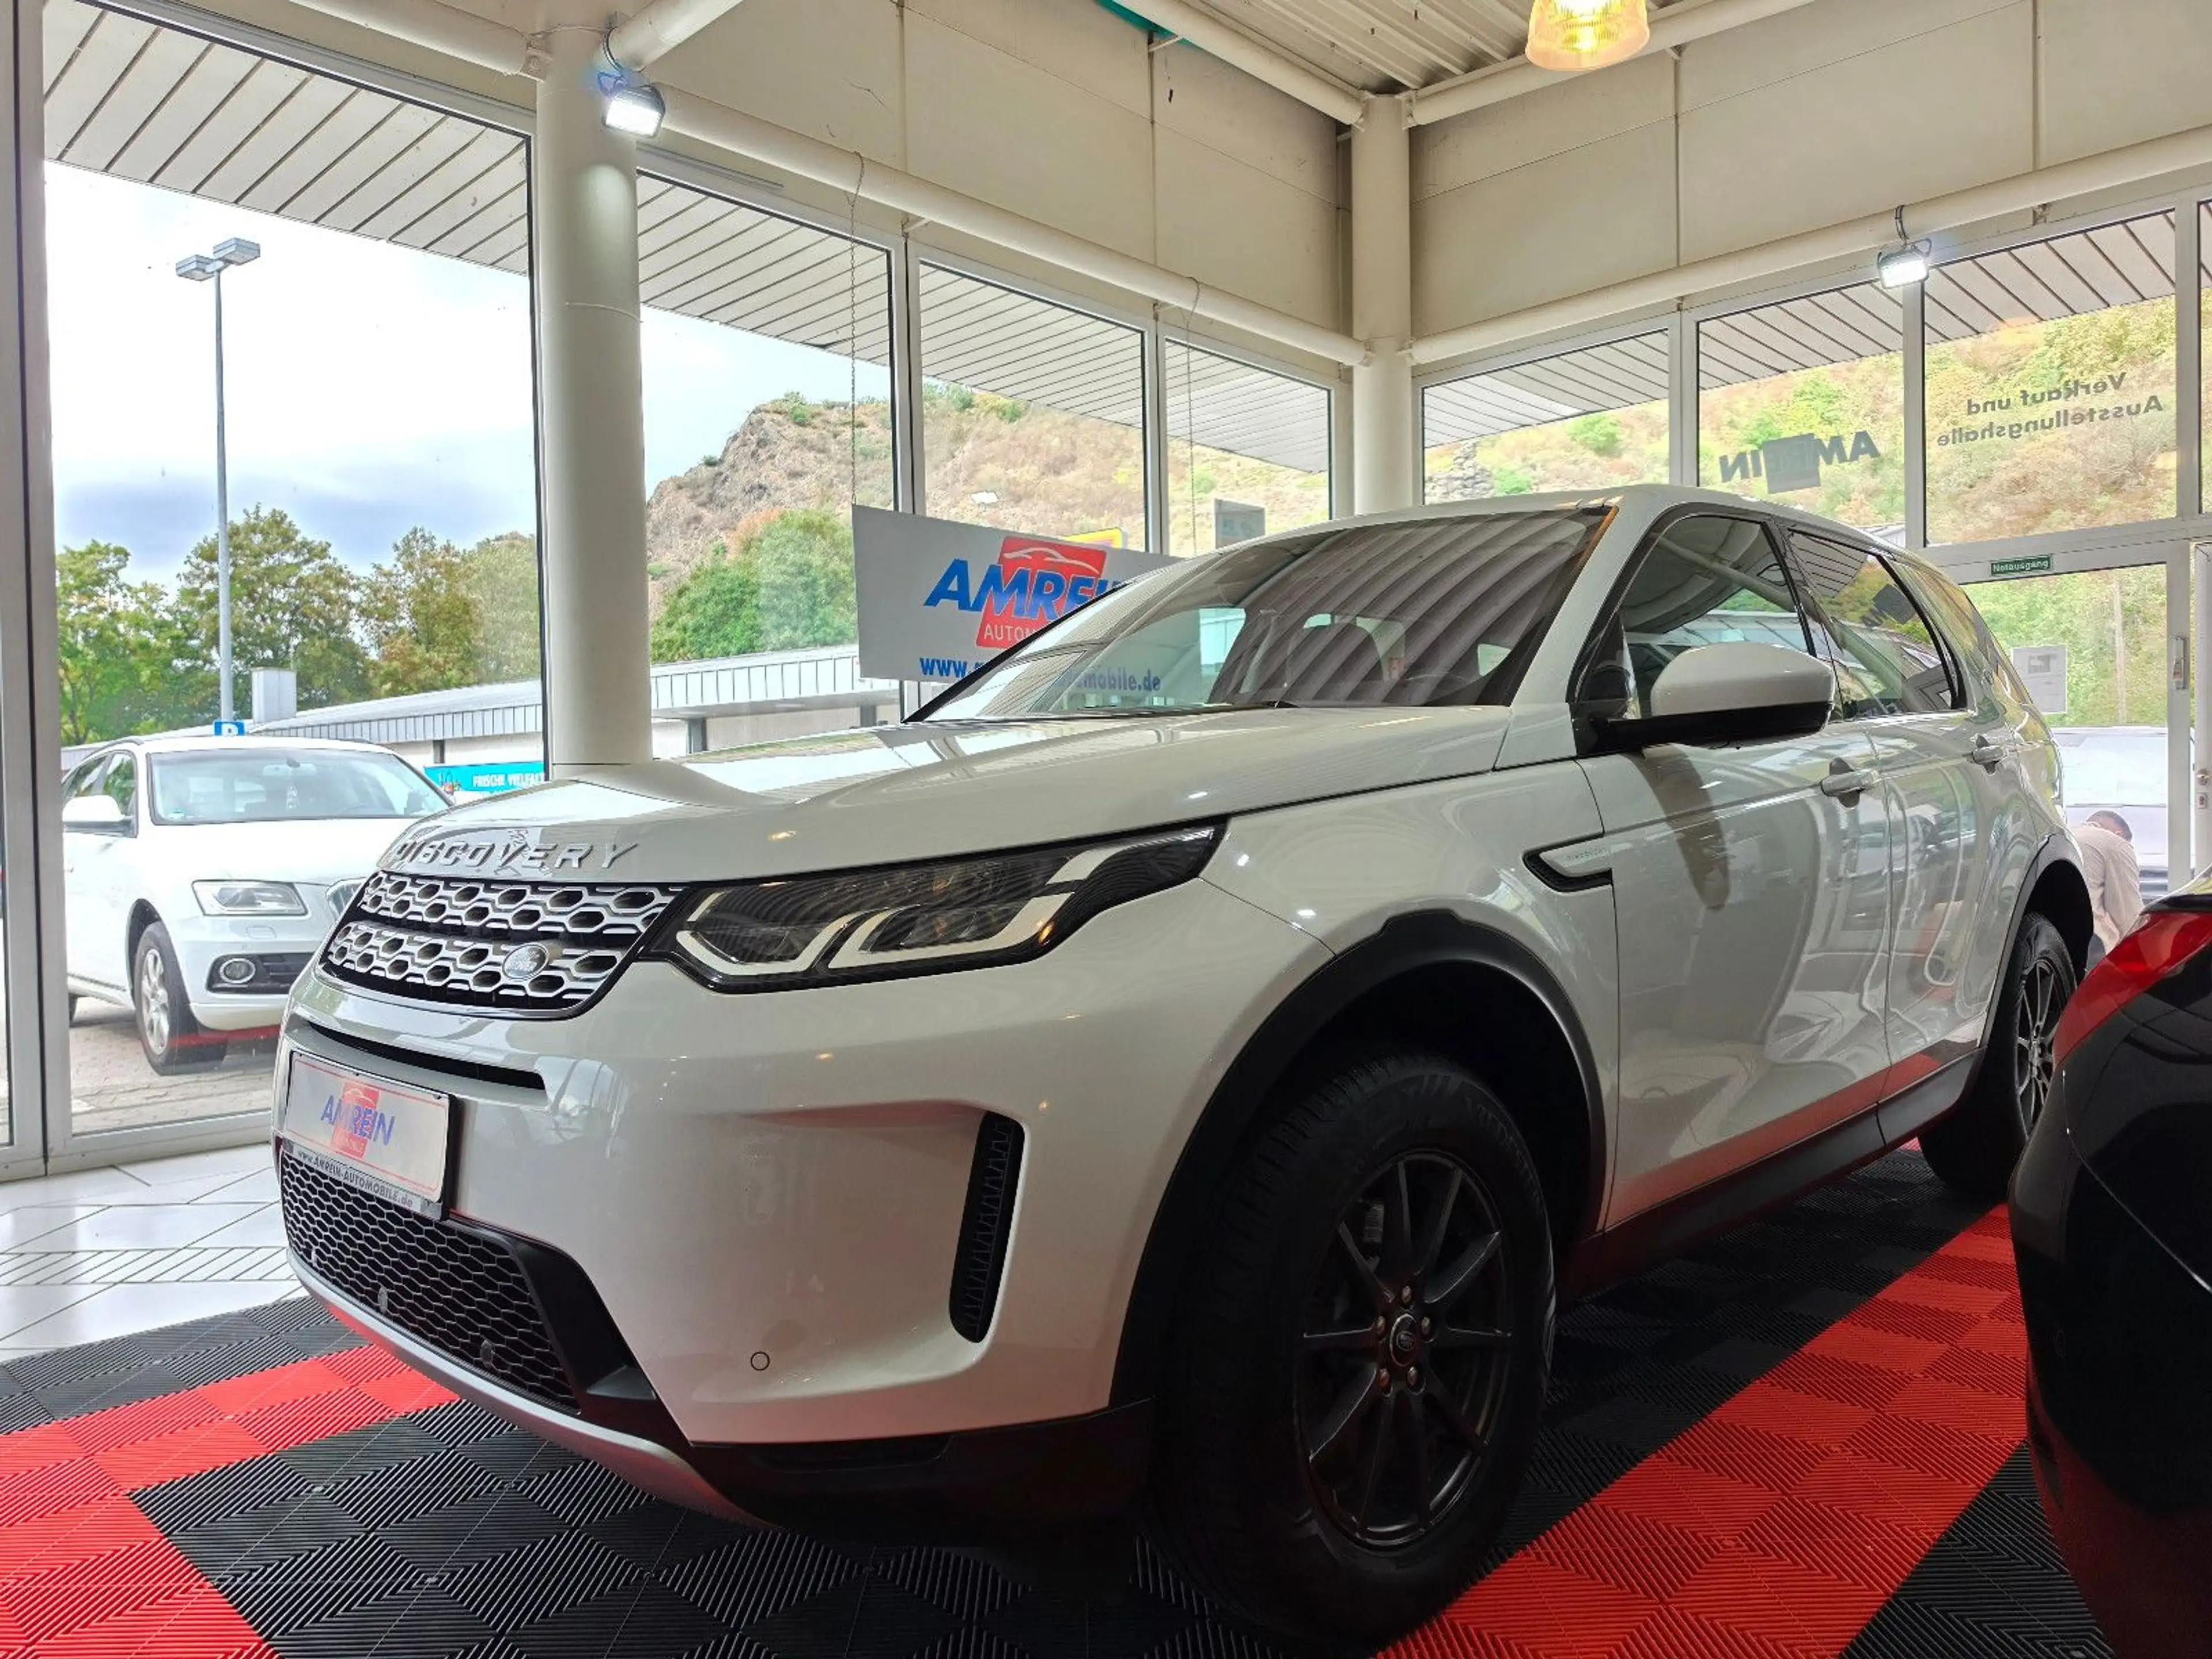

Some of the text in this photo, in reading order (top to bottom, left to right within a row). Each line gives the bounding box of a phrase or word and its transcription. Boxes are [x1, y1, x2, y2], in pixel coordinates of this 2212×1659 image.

[1993, 560, 2048, 571] Notausgang
[923, 558, 1126, 620] AMRE
[394, 842, 638, 869] DISCOVERY
[321, 1094, 395, 1146] AMREIN
